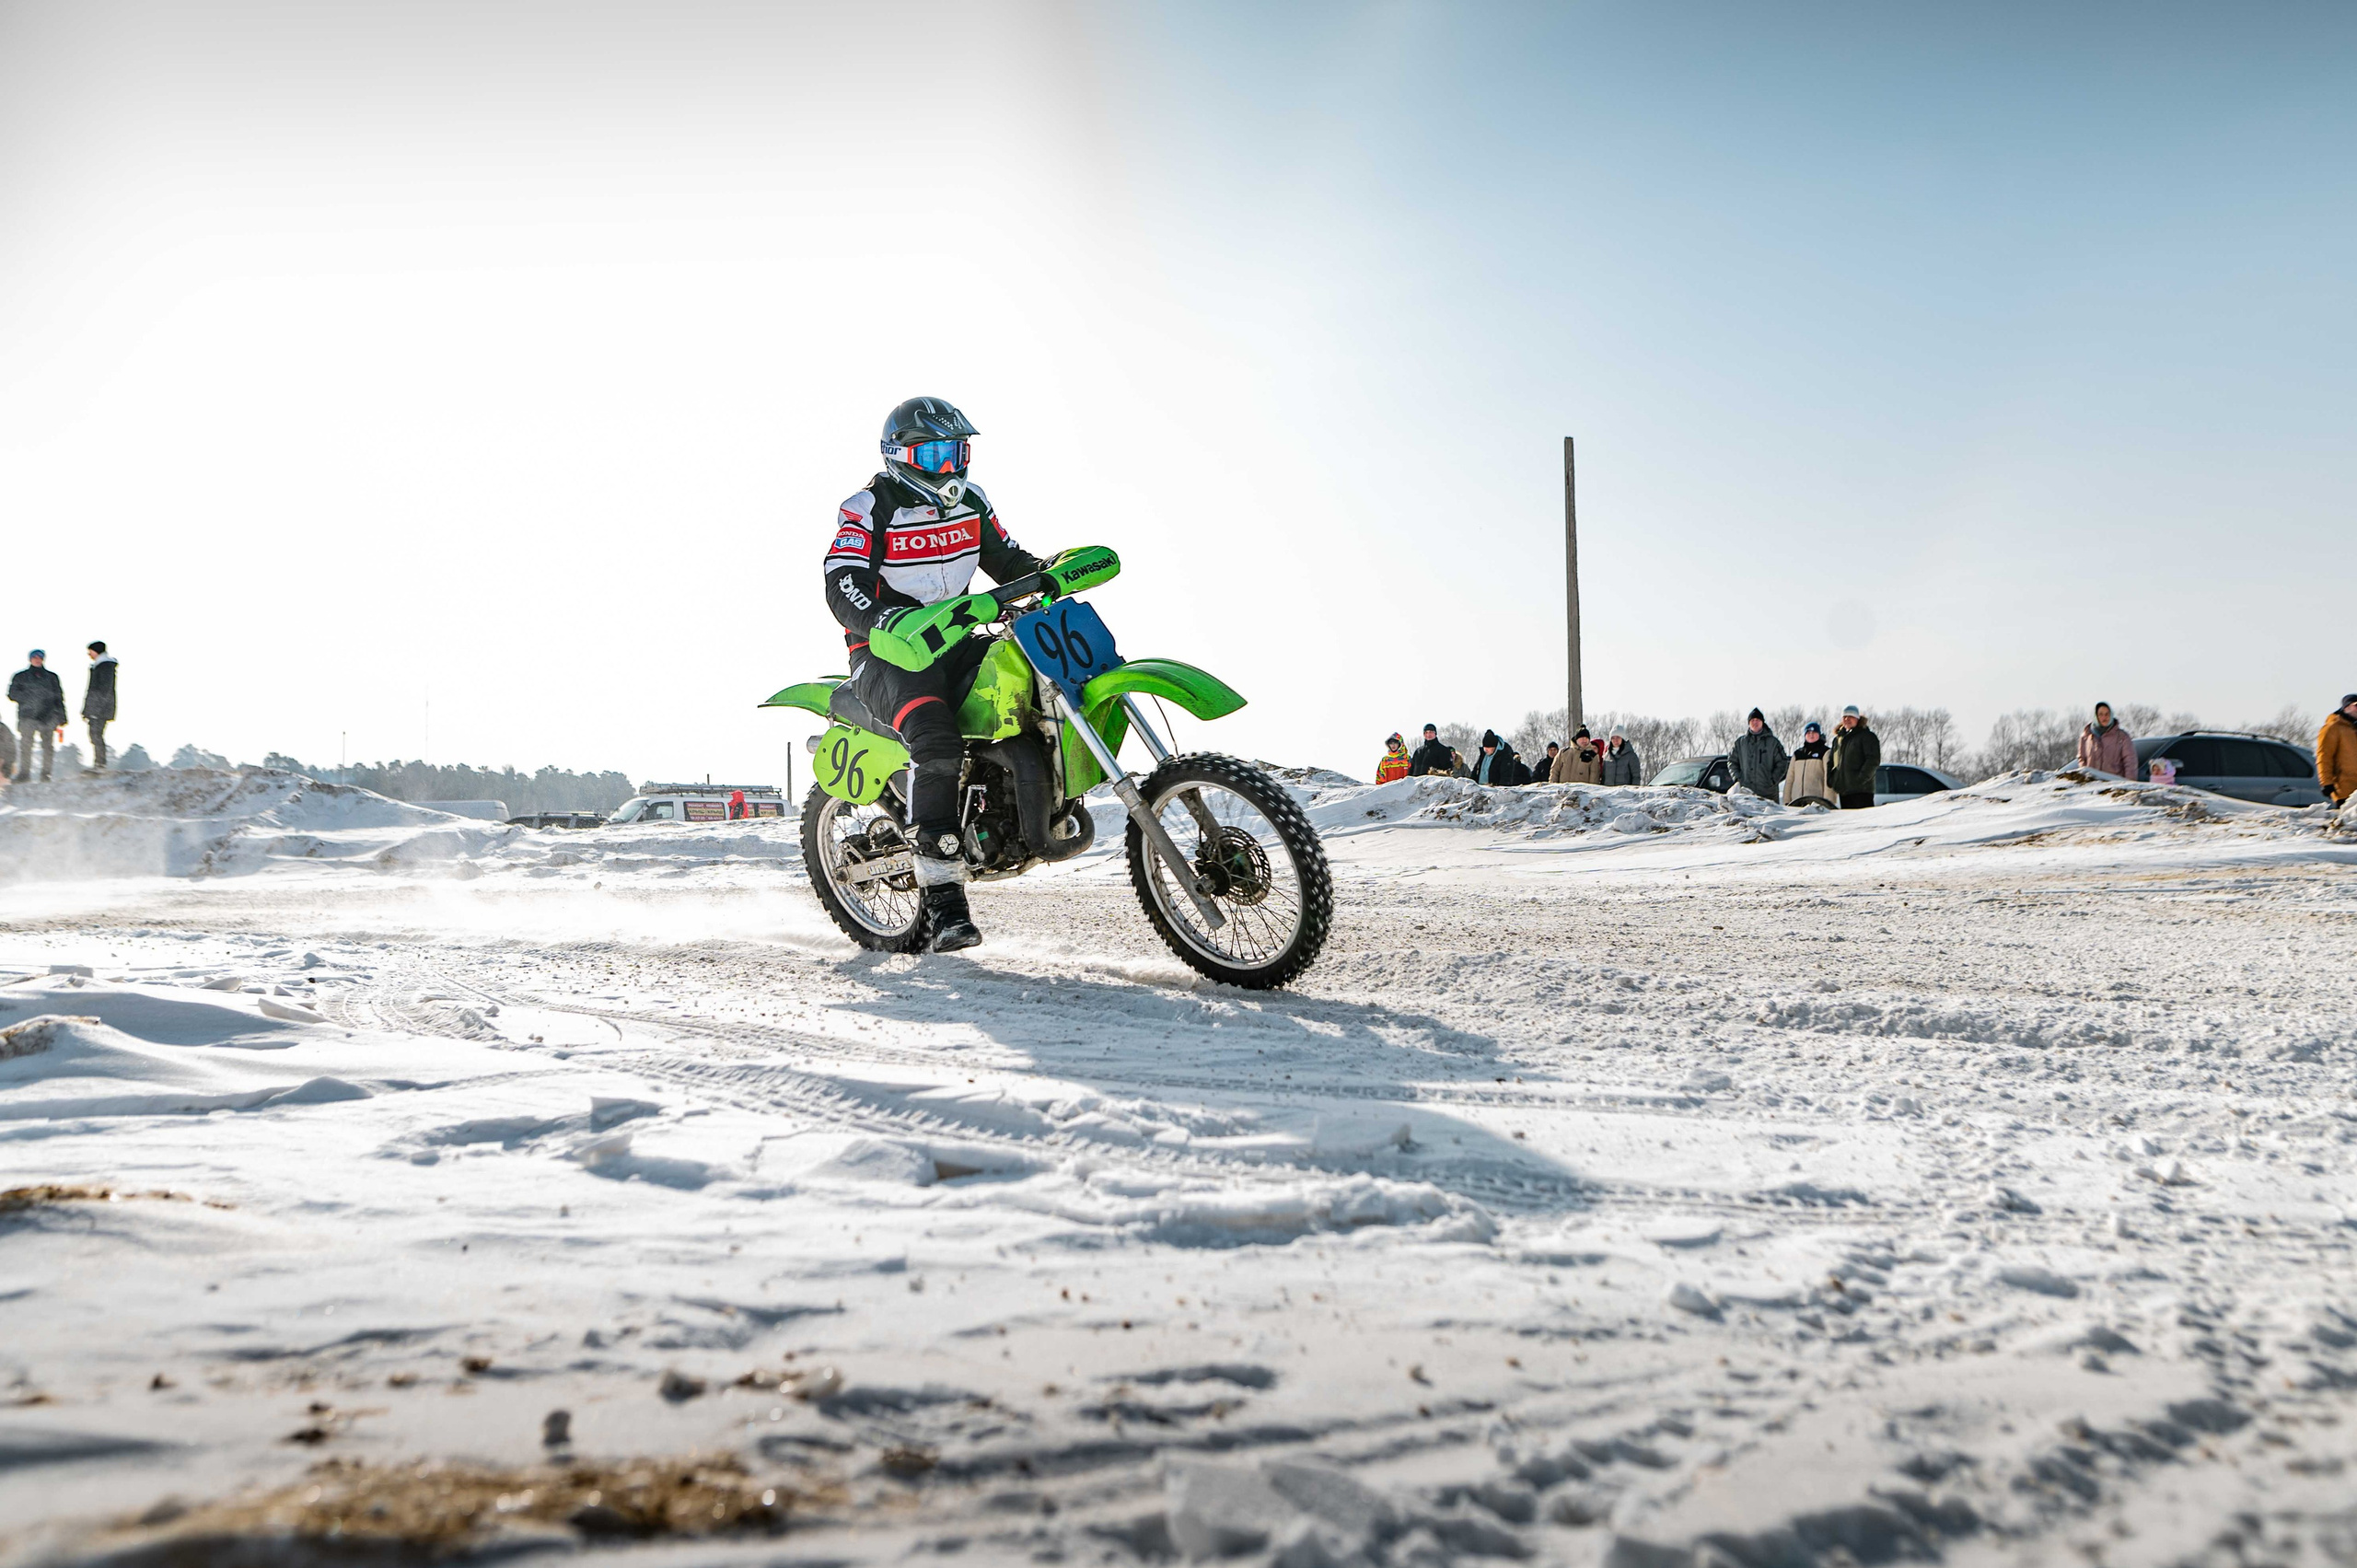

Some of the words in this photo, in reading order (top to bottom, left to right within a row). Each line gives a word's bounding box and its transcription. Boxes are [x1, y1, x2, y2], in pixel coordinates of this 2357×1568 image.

[840, 538, 863, 547] GAS
[892, 528, 973, 552] HONDA
[1061, 553, 1117, 585] Kawasaki
[1034, 609, 1094, 679] 96
[828, 738, 869, 799] 96
